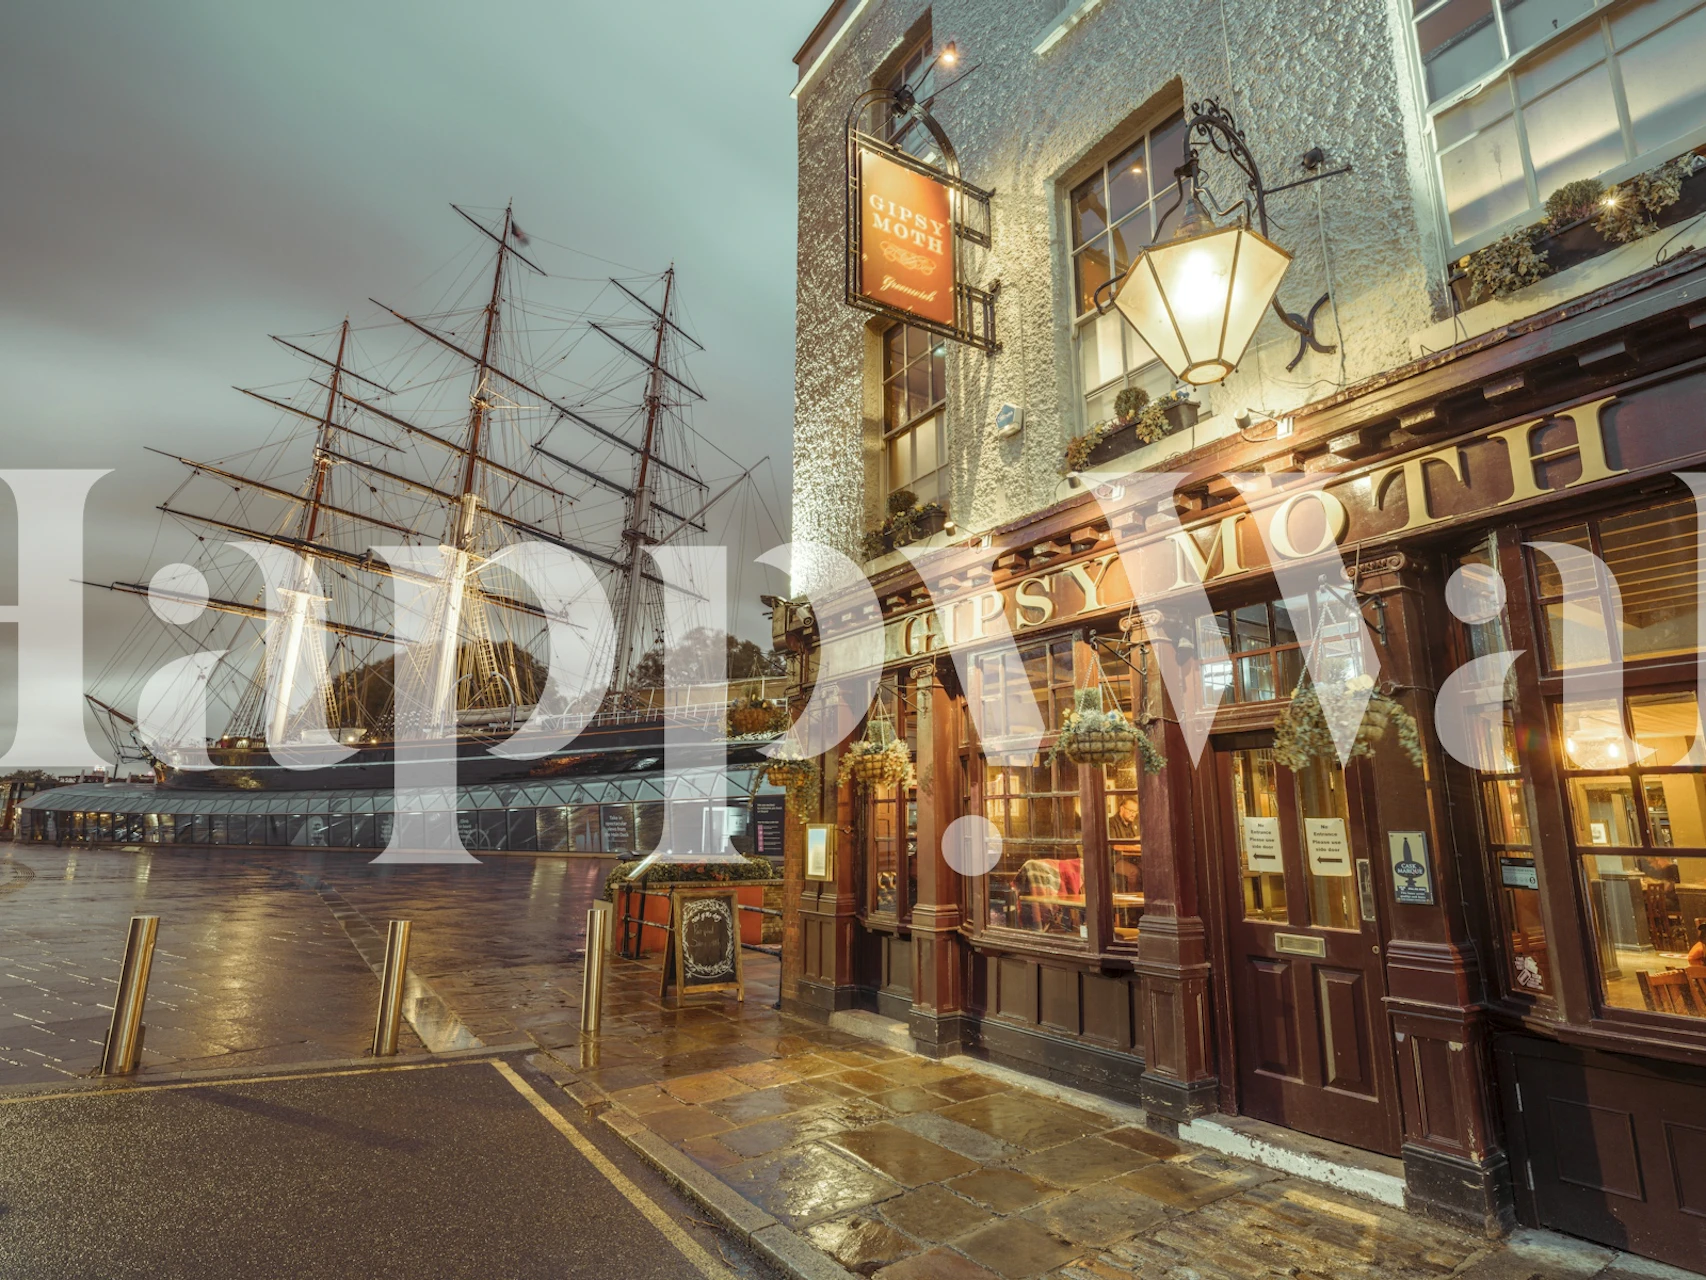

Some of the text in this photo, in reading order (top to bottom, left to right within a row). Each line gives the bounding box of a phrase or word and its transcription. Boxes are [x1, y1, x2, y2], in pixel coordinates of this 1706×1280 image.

[869, 194, 945, 236] GIPSY
[872, 213, 944, 256] MOTH
[903, 395, 1630, 657] GIPSY MOTH
[1397, 867, 1424, 875] MARQUE
